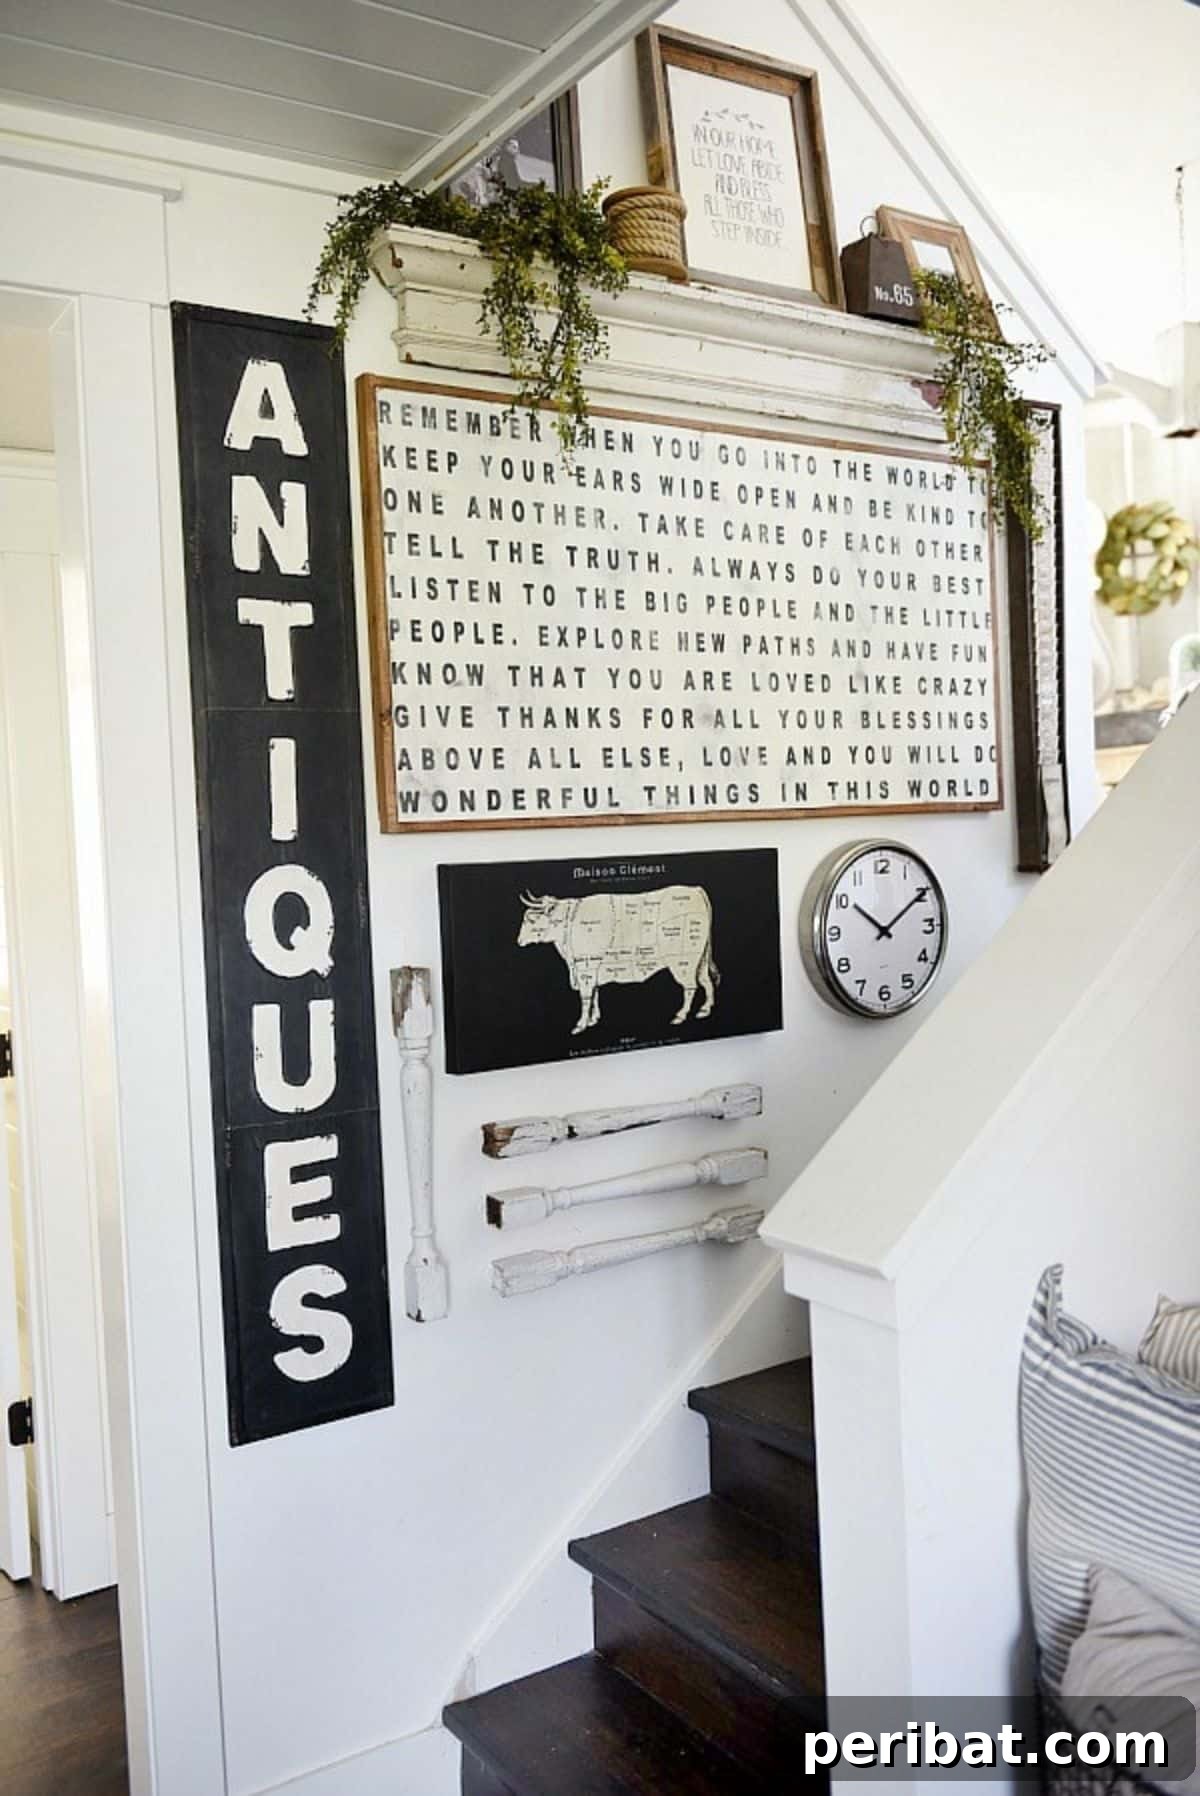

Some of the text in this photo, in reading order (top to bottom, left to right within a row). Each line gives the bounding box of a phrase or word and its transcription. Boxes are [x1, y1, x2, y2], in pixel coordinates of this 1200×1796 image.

[378, 400, 542, 443] REMEMBER
[652, 434, 700, 462] YOU
[717, 443, 747, 467] GO
[763, 449, 818, 476] INTO
[832, 458, 873, 483] THE
[886, 465, 953, 492] WORLD
[382, 444, 458, 475] KEEP
[480, 454, 556, 485] YOUR
[575, 465, 642, 494] EARS
[658, 474, 720, 502] WIDE
[736, 482, 796, 510] OPEN
[812, 492, 852, 516] AND
[868, 498, 892, 520] BE
[905, 503, 954, 527] KIND
[383, 487, 983, 563] ONE ANOTHER. TAKE CARE OF EACH OTHER
[383, 531, 984, 597] TELL THE TRUTH. ALWAYS DO YOUR BEST
[389, 574, 501, 604] LISTEN
[522, 583, 556, 607] TO
[575, 586, 626, 611] THE
[645, 590, 688, 614] BIG
[706, 594, 798, 619] PEOPLE
[813, 600, 856, 623] AND
[870, 604, 909, 627] THE
[389, 618, 988, 664] PEOPLE. EXPLORE NEW PATHS AND HAVE FUN
[391, 661, 987, 698] KNOW THAT YOU ARE LOVED LIKE CRAZY
[395, 704, 990, 730] GIVE THANKS FOR ALL YOUR BLESSINGS
[397, 746, 506, 772] ABOVE
[527, 746, 582, 770] ALL
[601, 745, 685, 772] ELSE,
[702, 745, 768, 767] LOVE
[785, 745, 832, 766] AND
[848, 744, 893, 765] YOU
[907, 743, 960, 764] WILL
[399, 778, 990, 814] WONDERFUL THINGS IN THIS WORLD
[223, 357, 354, 1384] ANTIQUES
[873, 858, 890, 875] 12
[902, 863, 908, 881] 1
[853, 869, 864, 887] 11
[835, 893, 848, 910] 10
[827, 925, 841, 942] 9
[922, 917, 935, 935] 3
[836, 956, 850, 973] 8
[916, 947, 929, 964] 4
[854, 978, 866, 997] 7
[901, 973, 914, 990] 5
[877, 984, 891, 1002] 6
